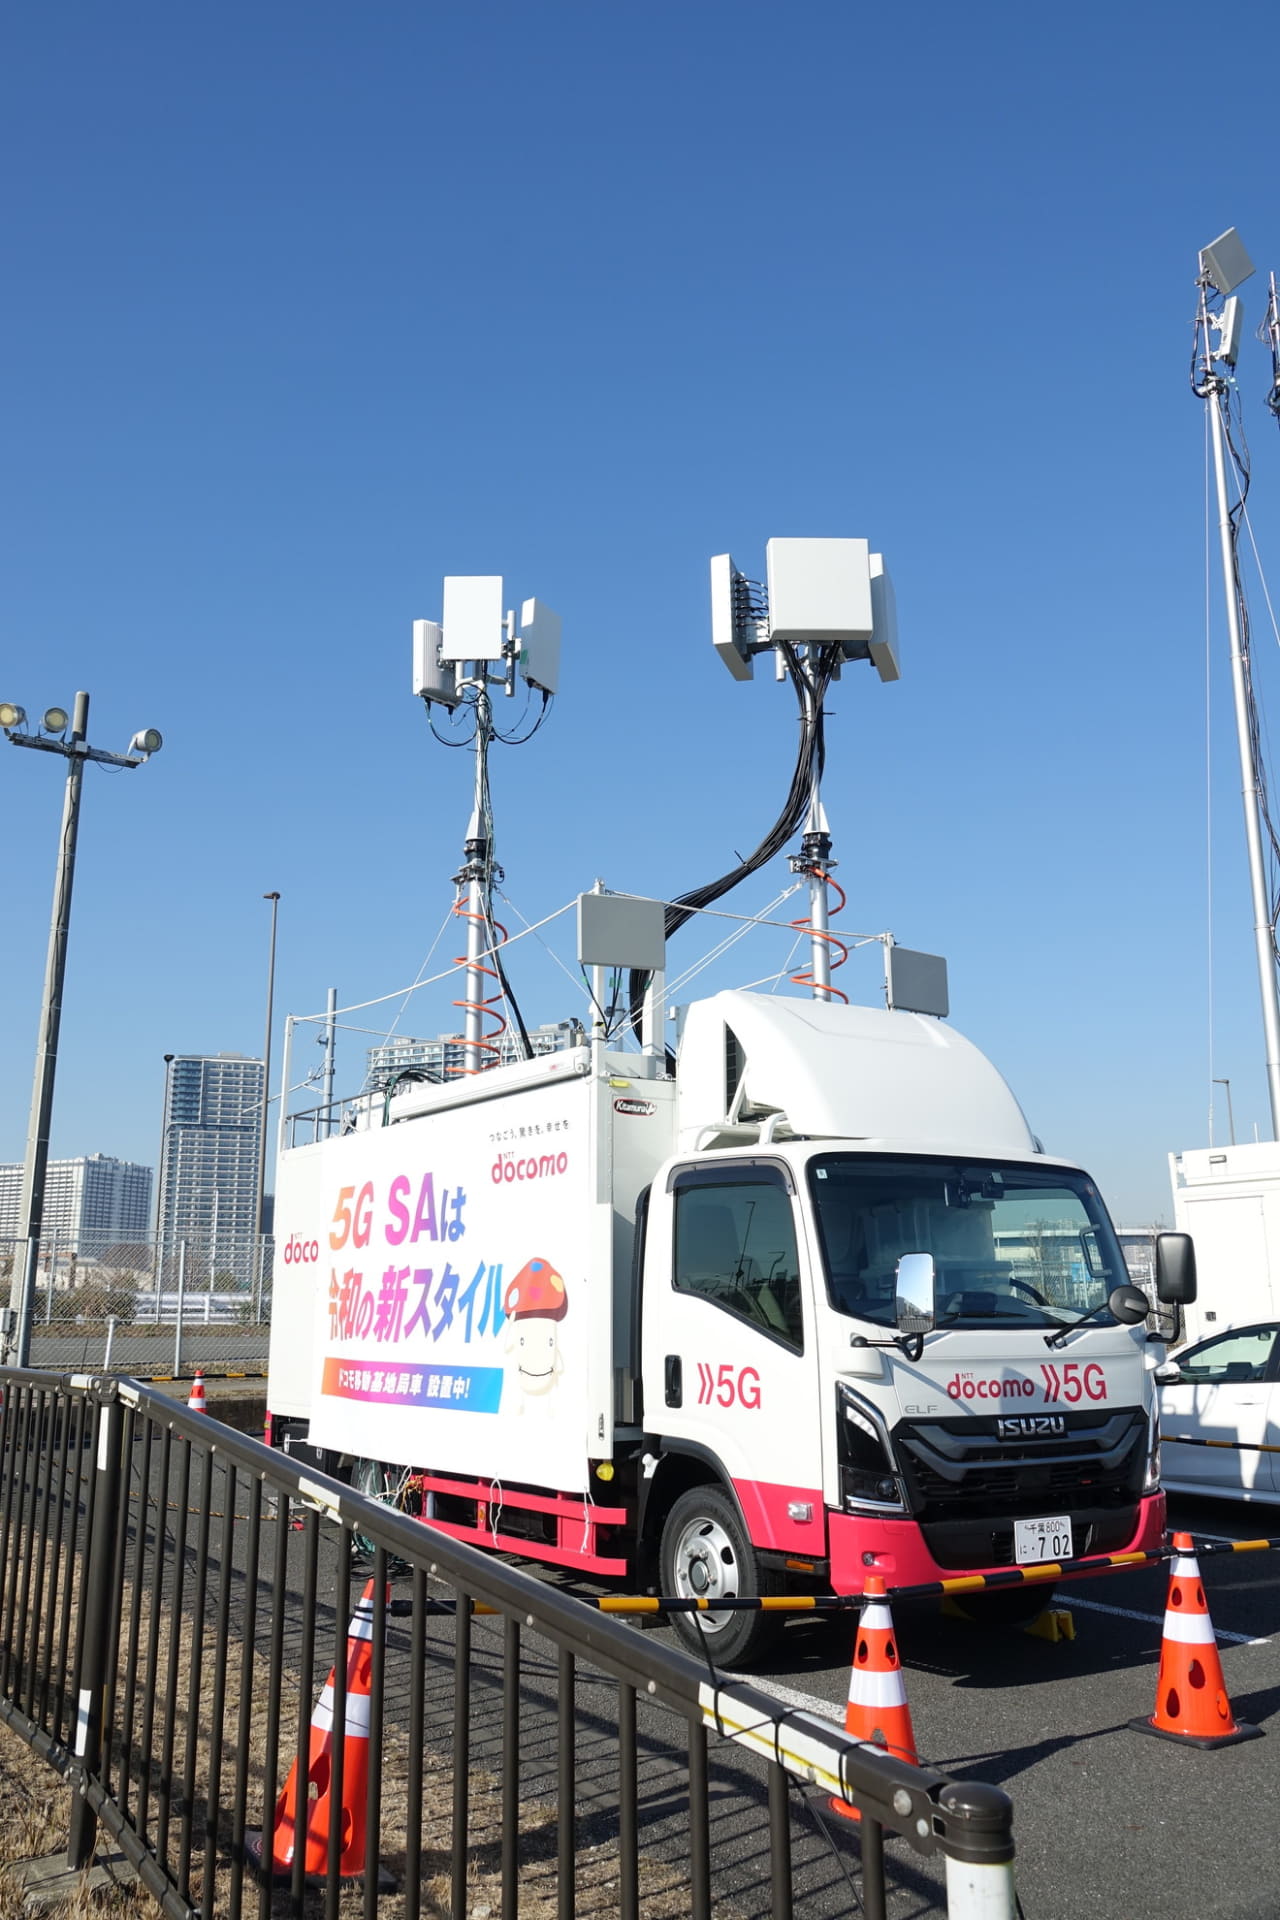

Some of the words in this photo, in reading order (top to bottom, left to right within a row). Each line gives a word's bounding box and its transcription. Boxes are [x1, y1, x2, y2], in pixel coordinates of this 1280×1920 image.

[491, 1152, 568, 1184] docomo
[328, 1180, 374, 1251] 5G
[384, 1172, 466, 1246] SAは
[284, 1233, 319, 1264] doco
[328, 1259, 506, 1343] 令和の新スタイル
[338, 1367, 424, 1397] ドコモ移動基地局車
[717, 1364, 761, 1409] 5G
[946, 1373, 1035, 1400] docomo
[961, 1372, 975, 1380] NTT
[1063, 1363, 1107, 1402] 5G
[904, 1404, 939, 1415] ELF
[997, 1416, 1065, 1438] ISUZU
